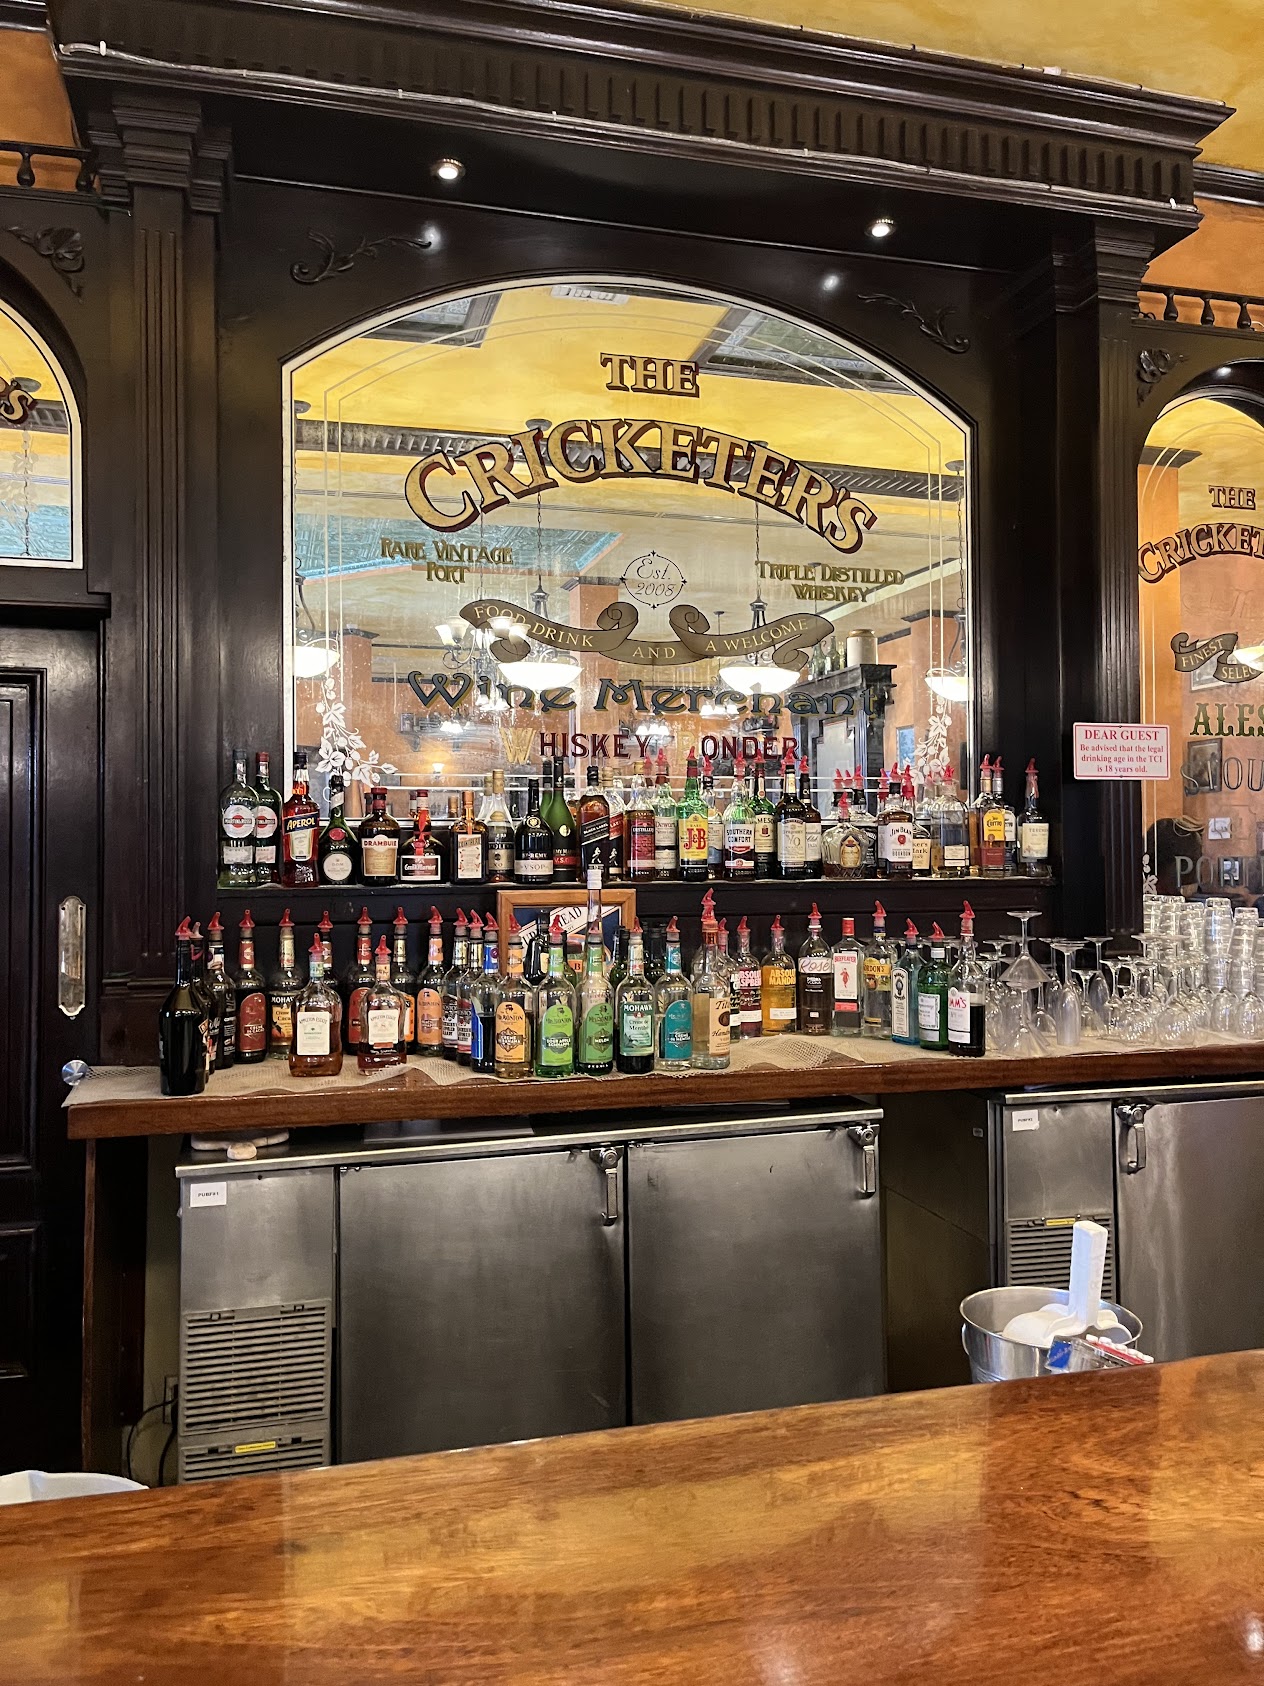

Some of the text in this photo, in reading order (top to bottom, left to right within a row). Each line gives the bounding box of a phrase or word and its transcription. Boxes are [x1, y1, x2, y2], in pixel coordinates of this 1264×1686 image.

[600, 353, 699, 397] THE
[404, 418, 878, 554] CRICKETER'S
[1208, 485, 1256, 510] THE
[380, 537, 514, 565] RARE VINTAGE
[426, 561, 471, 584] PORT
[636, 557, 671, 580] Est.
[755, 560, 905, 586] TRIPLE DISTILLED
[634, 582, 676, 597] 2008
[792, 583, 868, 603] WHISKEY
[531, 623, 594, 648] DRINK
[632, 645, 677, 660] AND
[705, 640, 717, 653] A
[723, 617, 809, 652] WELCOME
[1181, 636, 1224, 668] FINEST
[407, 670, 878, 717] Wine Merchant
[500, 727, 652, 765] WHISKEY
[1084, 729, 1160, 741] DEAR GUEST
[1080, 744, 1164, 754] Be advised that the legal
[1081, 754, 1112, 763] drinking
[1127, 755, 1134, 763] in
[1136, 755, 1147, 763] the
[1148, 755, 1162, 763] TCI
[1097, 765, 1103, 773] is
[1105, 765, 1113, 773] 18
[1135, 765, 1148, 773] old.
[286, 817, 316, 831] APEROL
[683, 827, 707, 851] J&B
[800, 957, 831, 973] Rosé
[623, 1004, 653, 1012] MOHAWK
